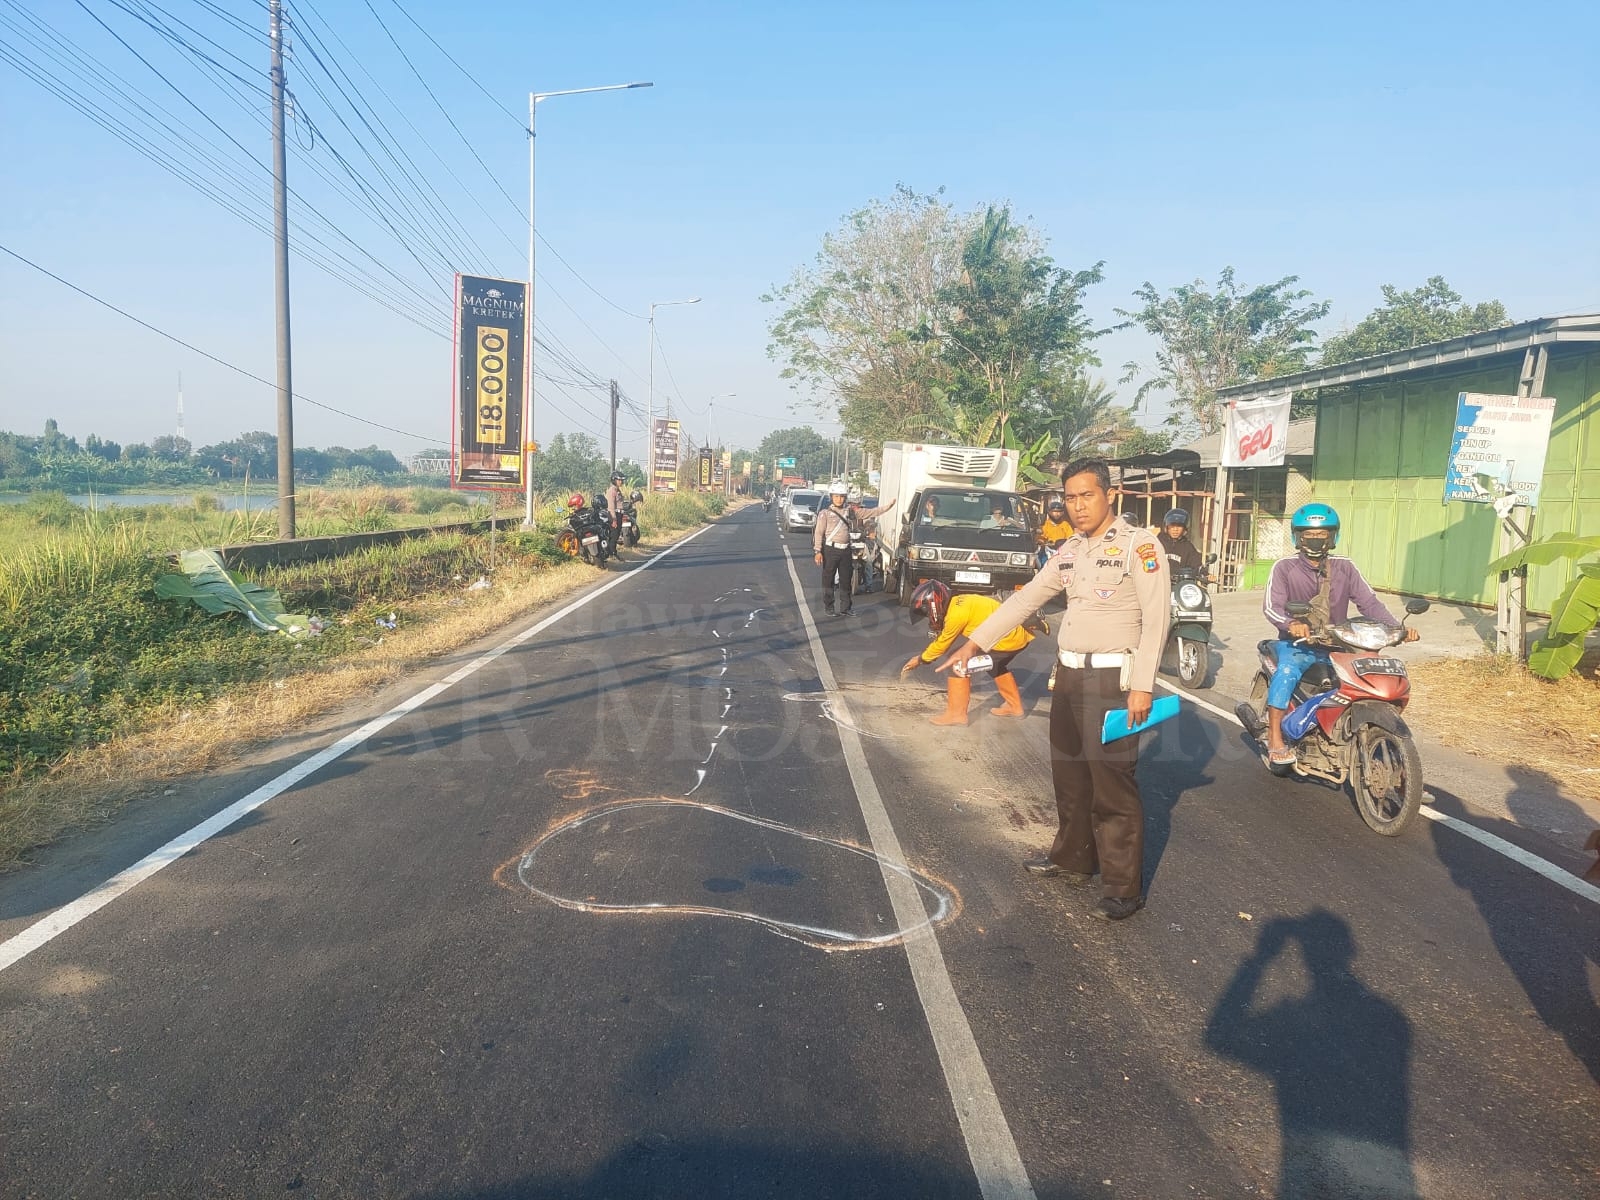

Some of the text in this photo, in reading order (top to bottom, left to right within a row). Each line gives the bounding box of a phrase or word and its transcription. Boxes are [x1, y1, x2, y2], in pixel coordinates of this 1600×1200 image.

[463, 295, 524, 312] MAGNUM
[473, 307, 515, 319] KRETEK
[480, 333, 504, 434] 18.000
[1479, 440, 1493, 449] UP
[1512, 481, 1537, 491] BODY
[1095, 558, 1124, 568] POLRI
